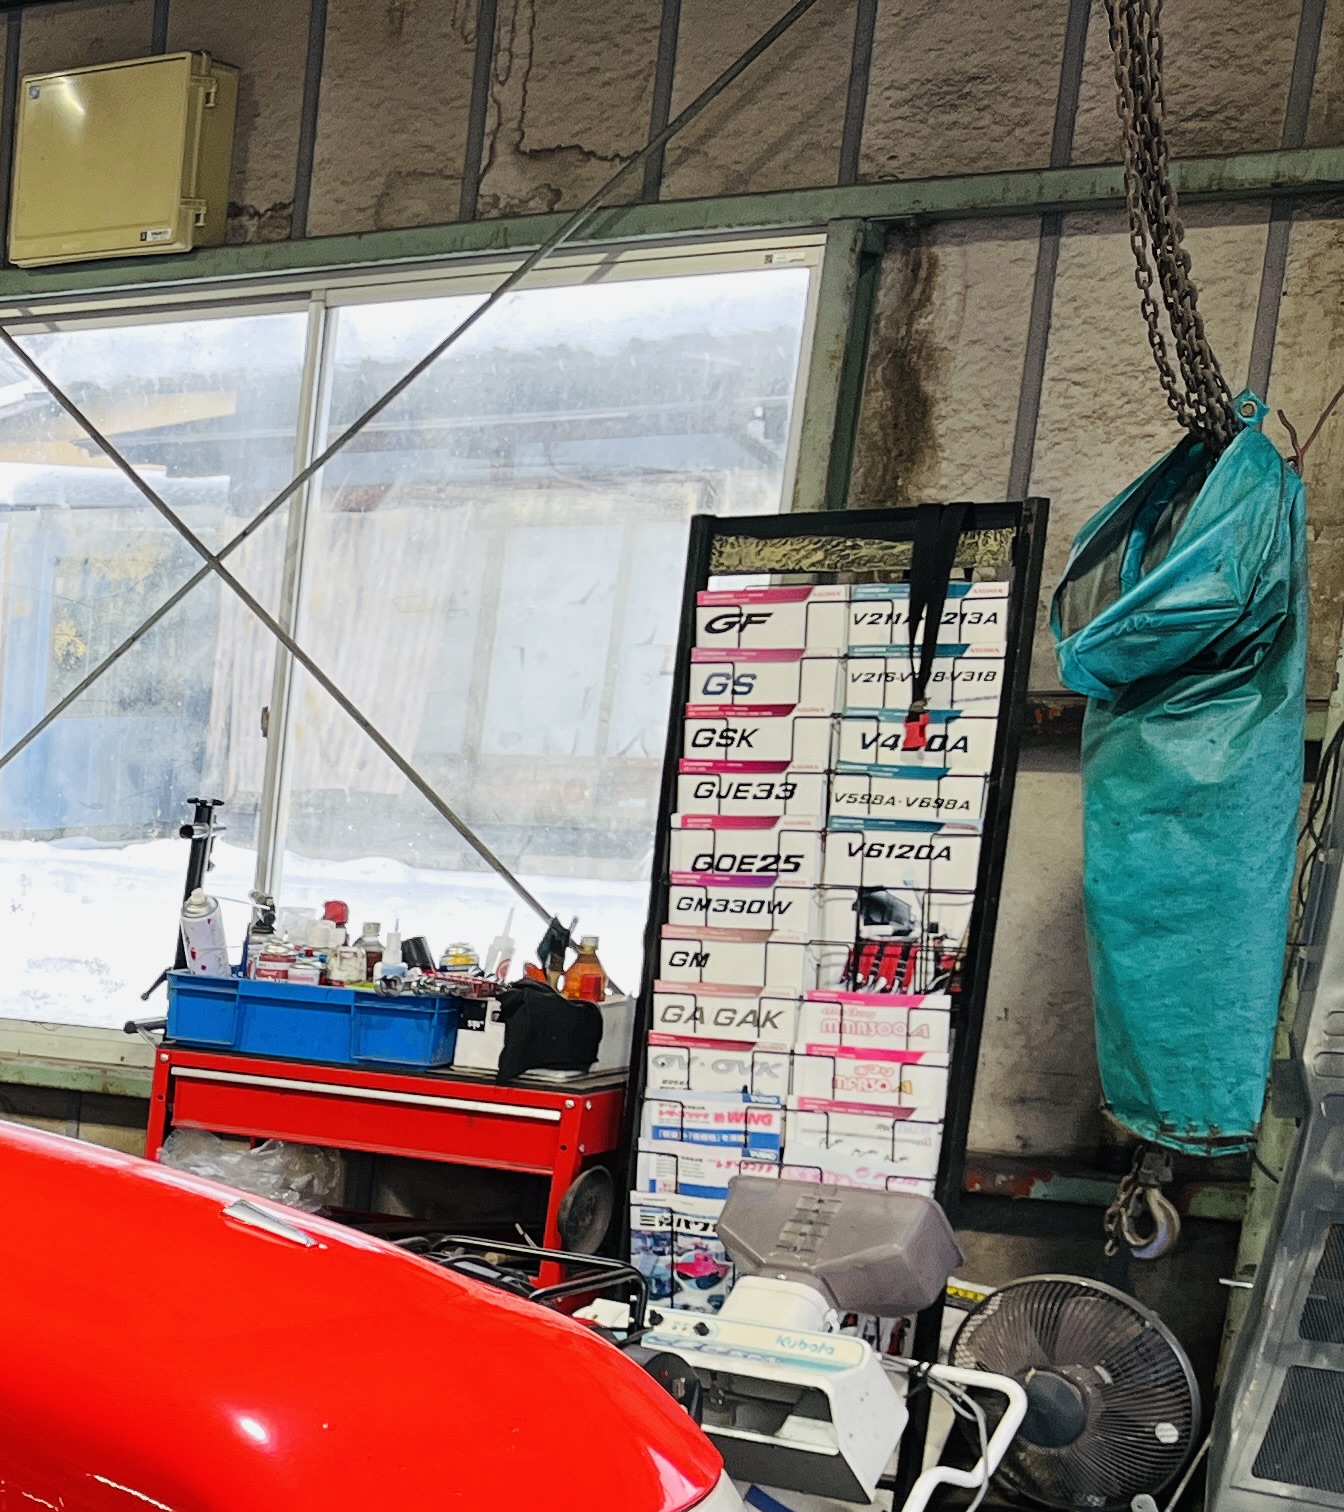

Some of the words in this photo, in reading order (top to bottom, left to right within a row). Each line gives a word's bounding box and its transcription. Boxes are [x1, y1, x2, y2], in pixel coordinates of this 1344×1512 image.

[705, 612, 773, 633] GF
[701, 672, 757, 696] GS
[691, 727, 760, 749] GSK
[860, 731, 970, 754] V40A
[693, 781, 798, 800] GJE33
[847, 841, 952, 861] V6120A
[675, 896, 793, 916] GM330W
[668, 951, 711, 968] GM
